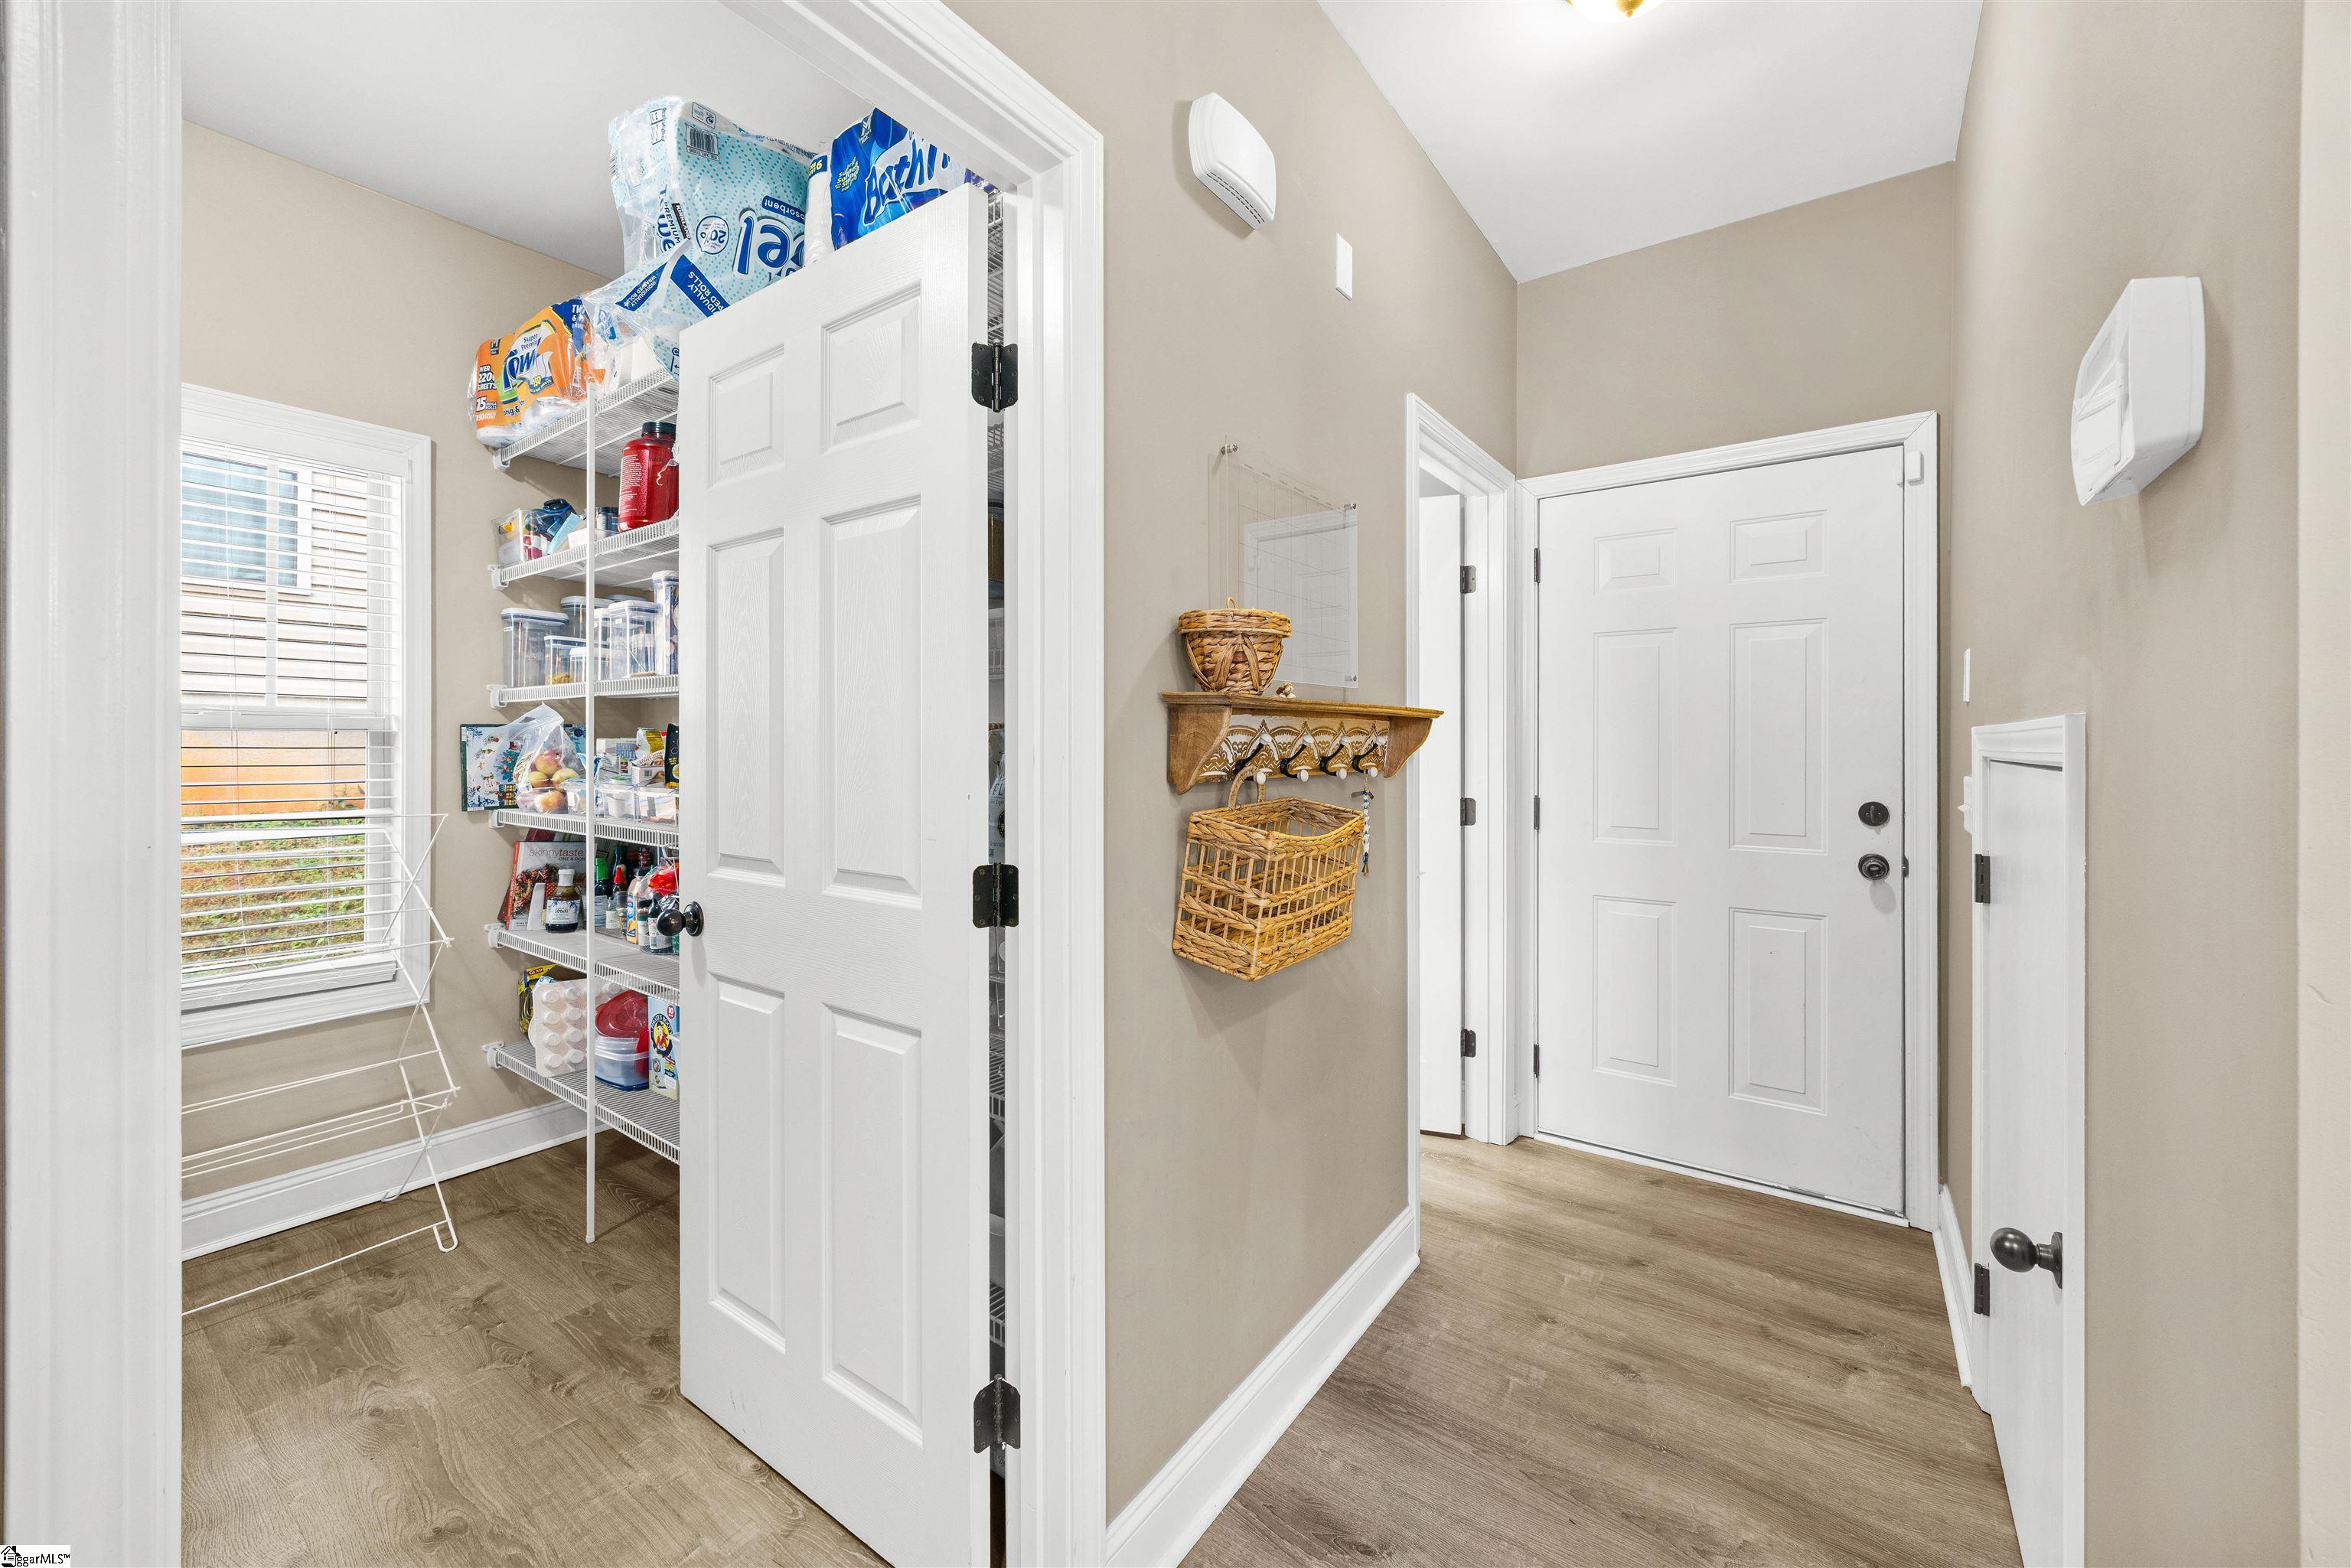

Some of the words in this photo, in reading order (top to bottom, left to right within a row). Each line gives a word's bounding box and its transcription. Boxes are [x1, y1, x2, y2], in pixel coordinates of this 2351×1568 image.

[664, 201, 681, 243] PREMIUM
[765, 199, 805, 222] bsorbent
[631, 281, 657, 306] INDIVIDUALLY
[688, 271, 712, 295] ROLLS
[688, 283, 717, 313] IDUALLY
[523, 333, 539, 344] Super
[502, 348, 540, 392] Tow
[476, 396, 487, 412] 15
[528, 967, 543, 976] GLAD
